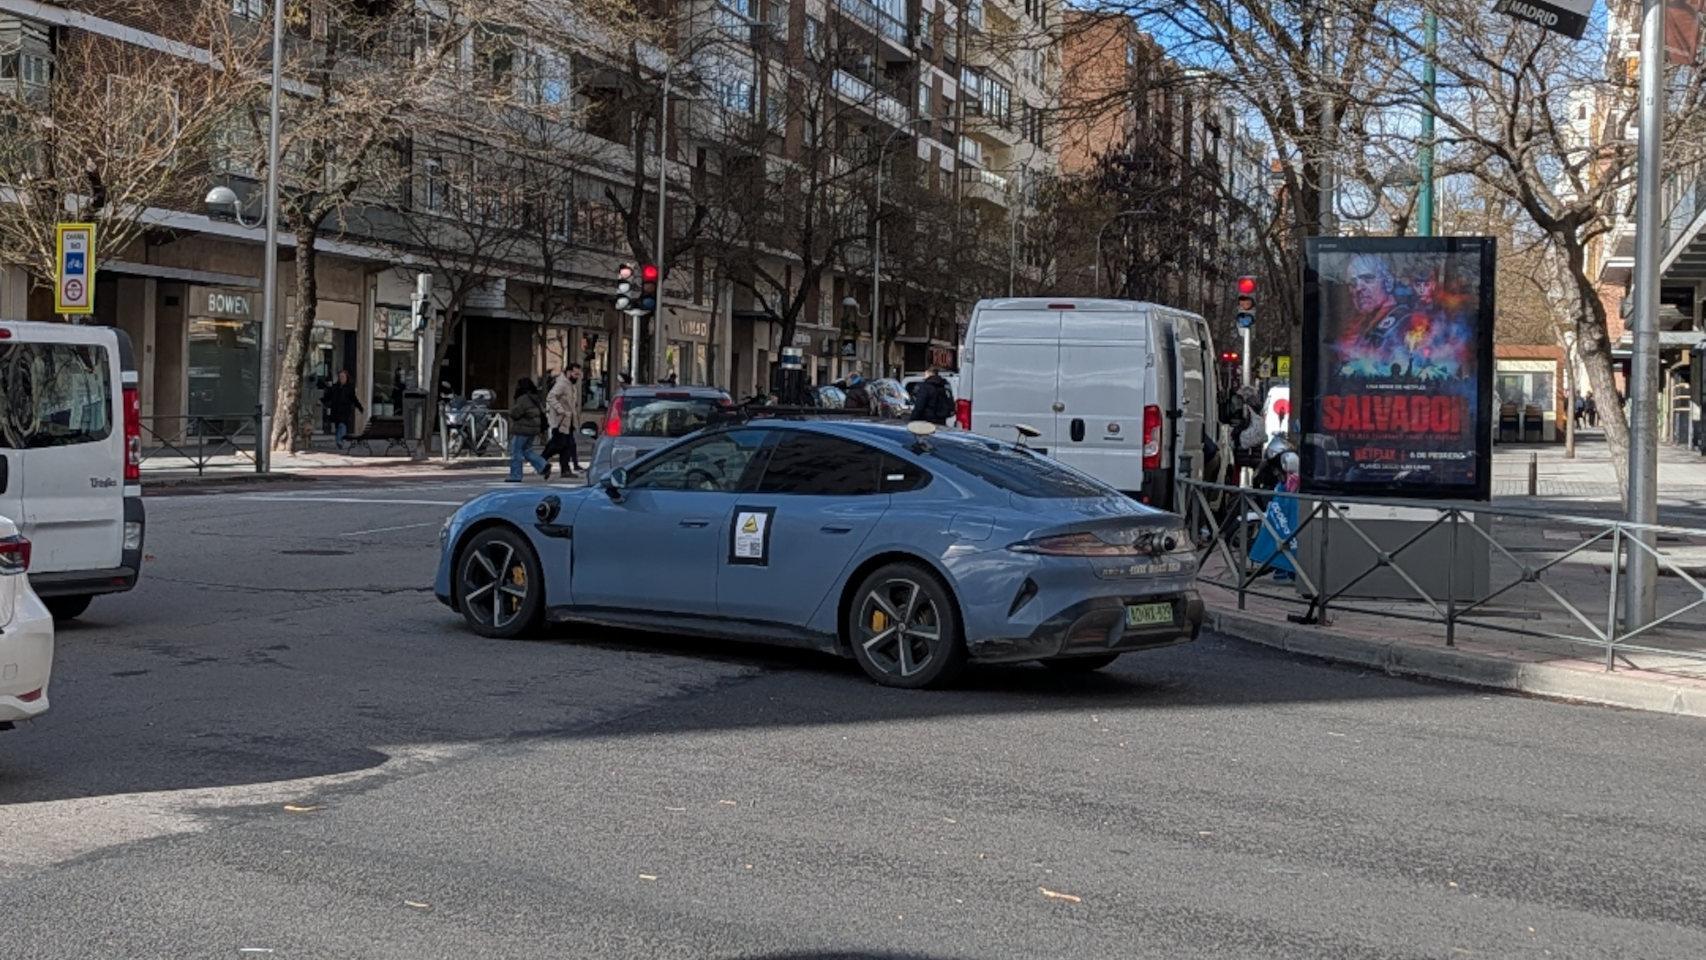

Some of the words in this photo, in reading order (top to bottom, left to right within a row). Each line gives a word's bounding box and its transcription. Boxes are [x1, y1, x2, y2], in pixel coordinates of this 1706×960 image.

[1509, 0, 1559, 26] MADRID
[208, 293, 250, 314] BOWEN
[1354, 448, 1397, 461] NETFLIX
